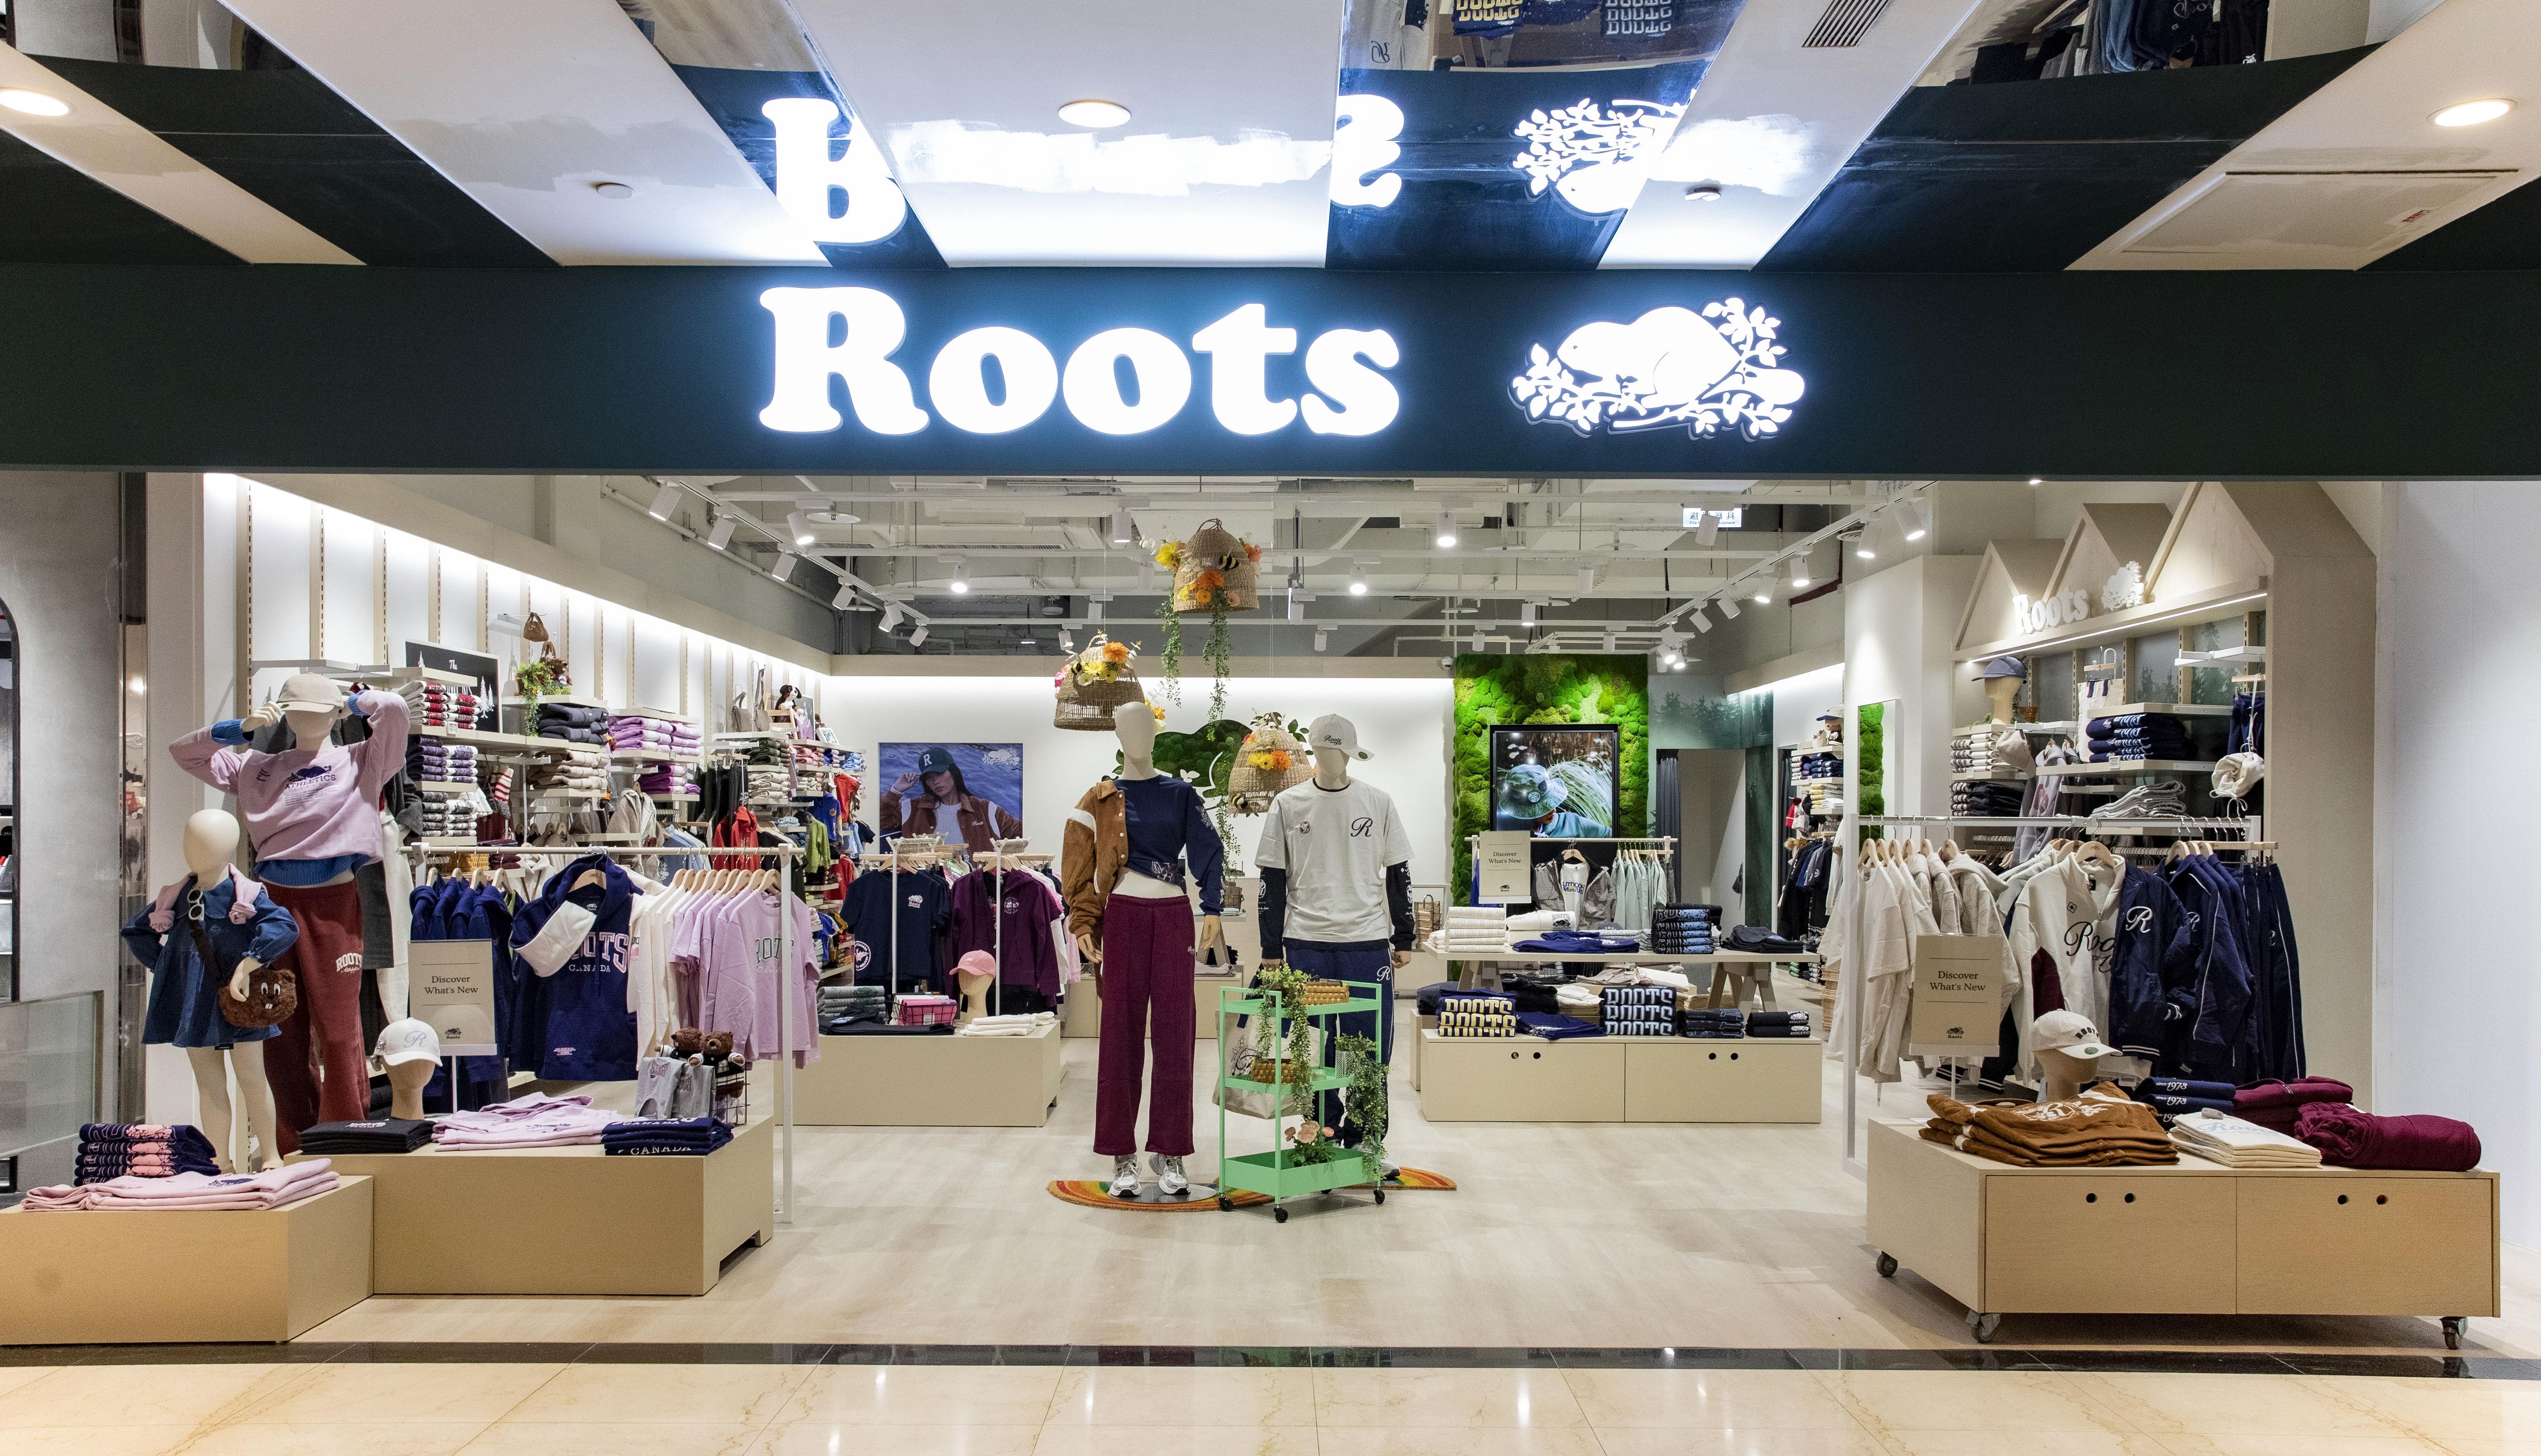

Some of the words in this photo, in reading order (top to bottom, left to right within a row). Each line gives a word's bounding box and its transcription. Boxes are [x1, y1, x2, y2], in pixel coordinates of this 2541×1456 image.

[759, 287, 1399, 435] Roots
[2012, 589, 2089, 635] Roots
[449, 659, 458, 670] The
[923, 753, 932, 766] R
[285, 775, 336, 789] ATHLETICS
[1350, 817, 1373, 837] R
[2125, 906, 2154, 933] R
[2064, 921, 2115, 956] Roo
[571, 932, 629, 973] OTS
[432, 976, 471, 984] Discover
[1376, 966, 1390, 981] R
[1938, 971, 1979, 979] Discover
[1930, 982, 1961, 990] What's
[1964, 983, 1986, 991] New
[403, 1030, 427, 1048] R
